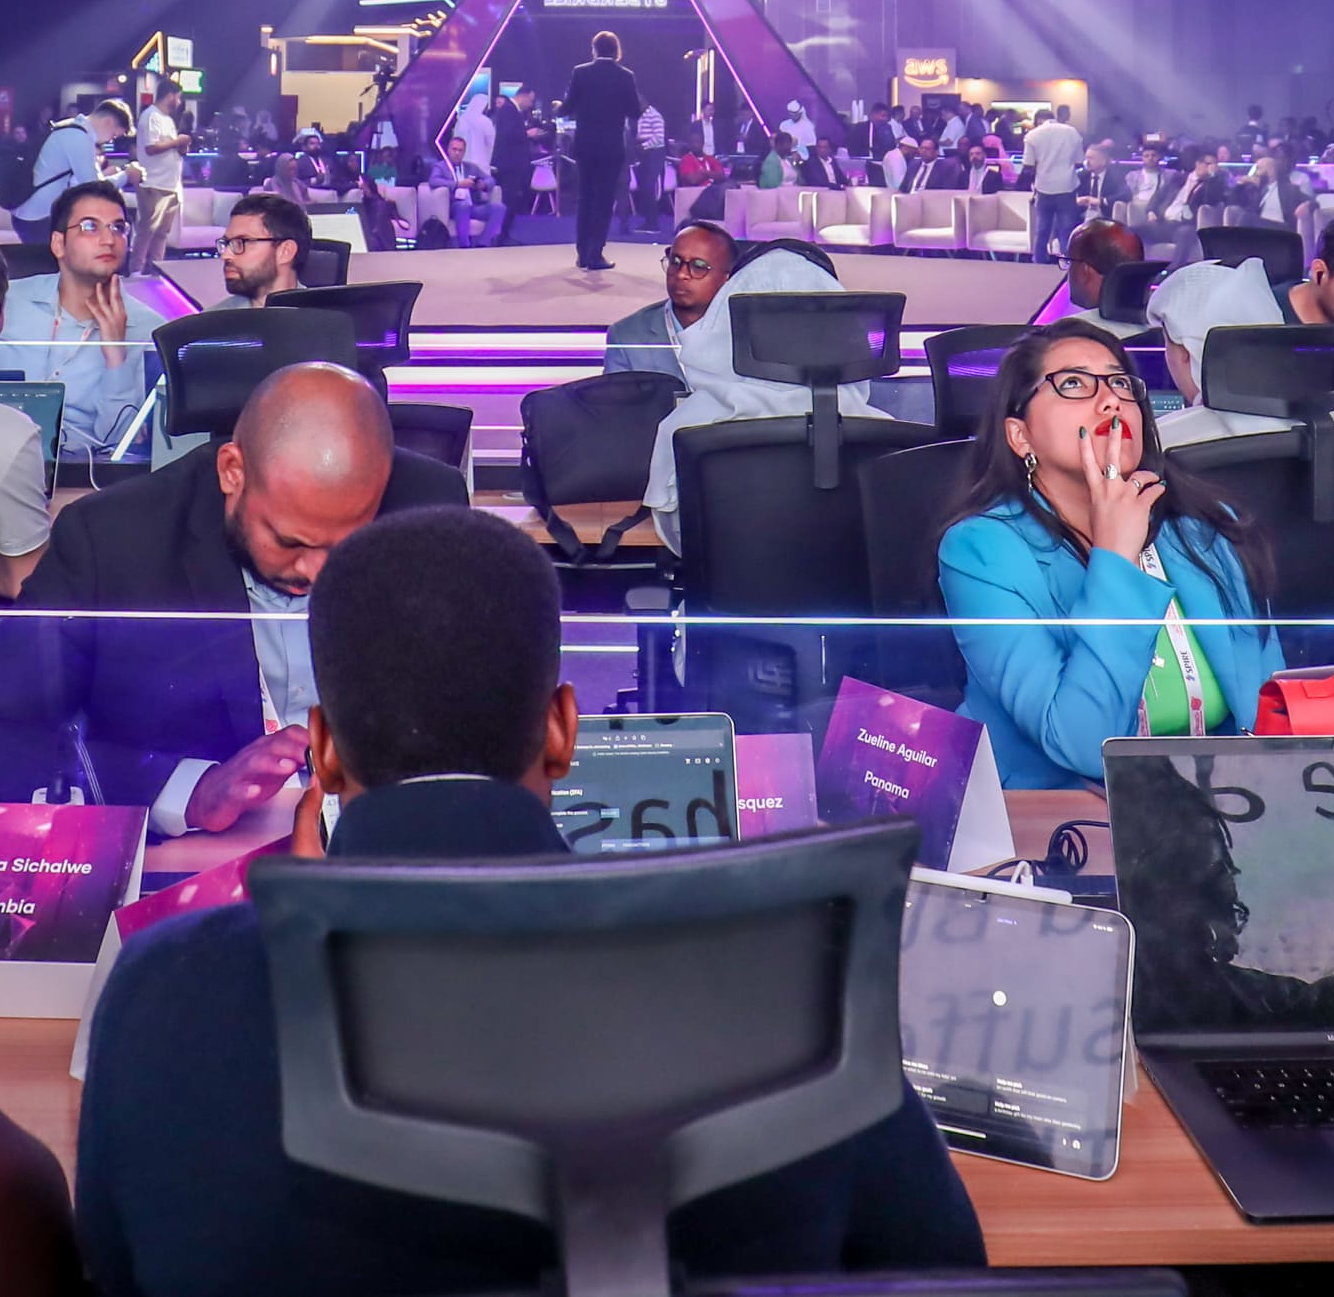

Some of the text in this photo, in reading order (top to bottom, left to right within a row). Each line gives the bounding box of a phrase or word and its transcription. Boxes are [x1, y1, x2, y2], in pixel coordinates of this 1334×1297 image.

[904, 58, 948, 76] aws
[857, 728, 937, 768] Zueline Aguilar
[864, 771, 910, 799] Panama
[738, 797, 784, 812] squez
[11, 858, 92, 874] Sichalwe
